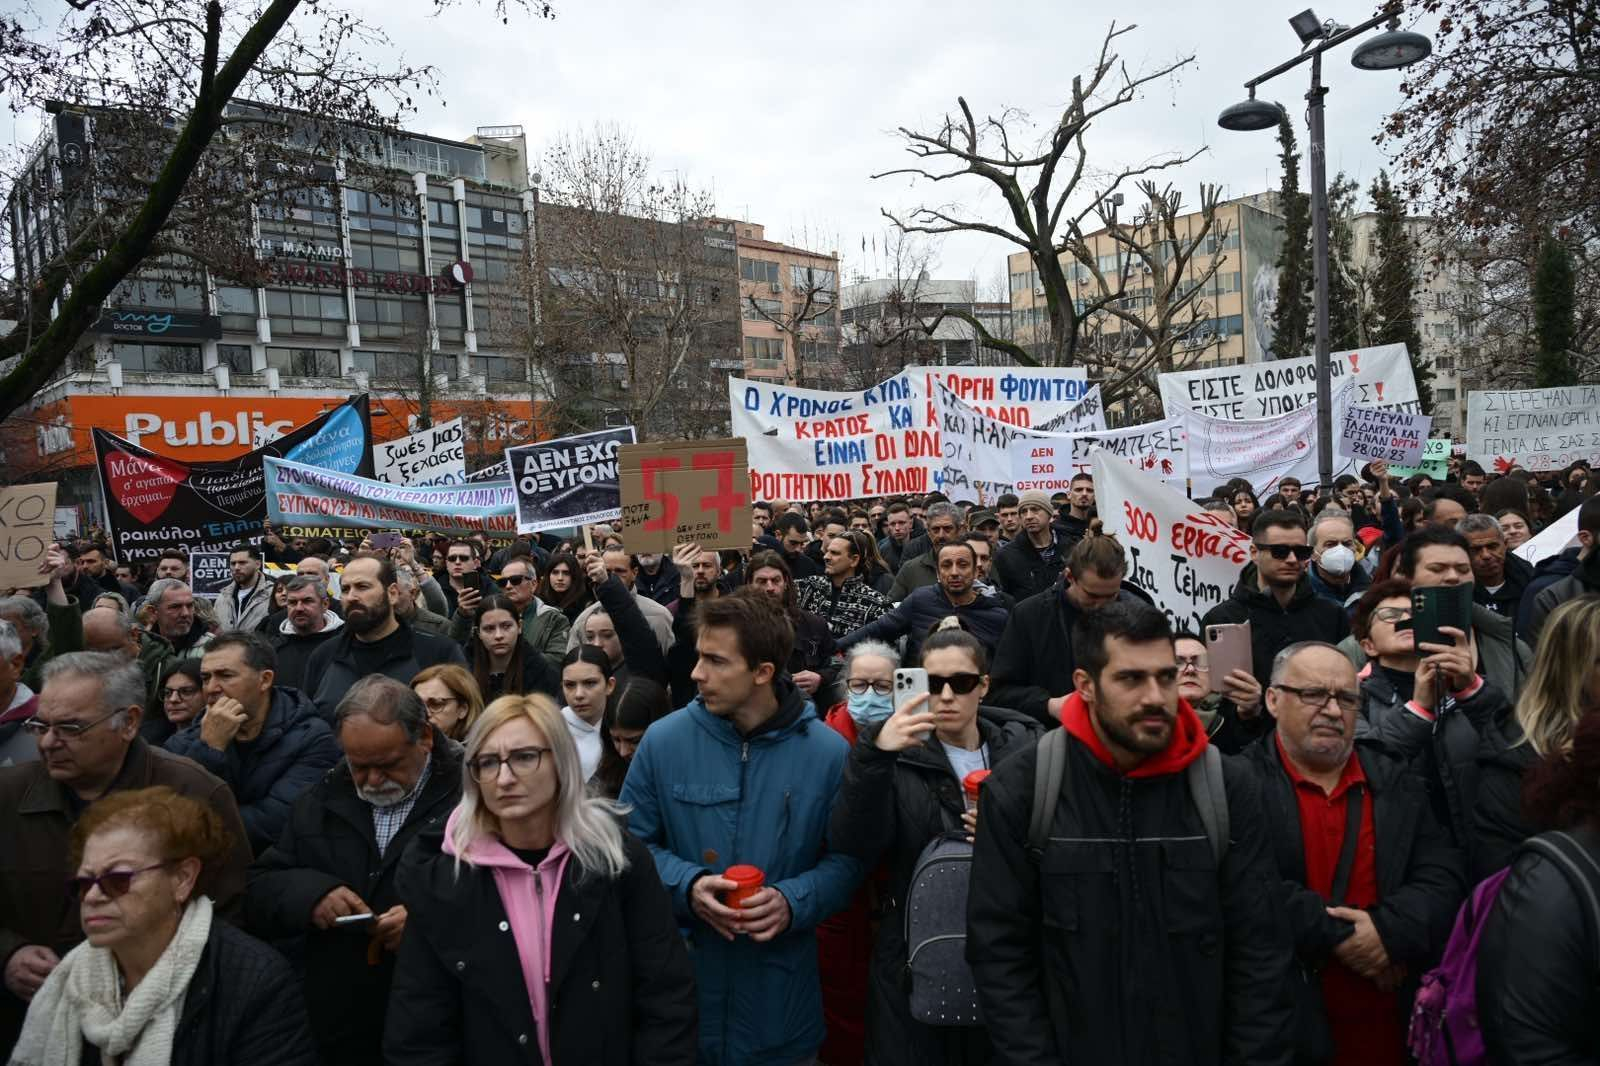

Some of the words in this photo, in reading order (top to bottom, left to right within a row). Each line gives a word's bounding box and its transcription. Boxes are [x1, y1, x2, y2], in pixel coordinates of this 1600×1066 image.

[1188, 375, 1244, 401] ΕΙΣΤΕ
[1254, 359, 1345, 392] ΔΟΛΟΦΟΟΙ
[770, 389, 853, 417] ΧΡΟΝΟΣ
[947, 374, 995, 401] ΟΡΓΗ
[124, 411, 294, 447] Public
[795, 413, 873, 440] ΚΡΑΤΟΣ
[1343, 429, 1389, 447] ΕΓΙΝΑΝ
[1391, 438, 1419, 449] ΟΡΓΗ
[523, 448, 571, 475] ΔΕΝ
[815, 438, 867, 467] ΕΙΝΑΙ
[875, 433, 897, 462] ΟΙ
[1030, 447, 1054, 458] ΔΕΝ
[519, 461, 621, 496] ΟΞΥΓΟΝ
[1031, 463, 1055, 474] ΕΧΩ
[365, 485, 393, 500] ΤΟΥ
[640, 450, 747, 535] 57
[1016, 479, 1070, 491] ΟΞΥΓΟΝΟ
[277, 494, 357, 516] ΣΥΓΚΡΟΥΣΗ
[487, 514, 516, 532] ΑΝΑ
[623, 503, 650, 515] ΠΟΤΕ
[1123, 500, 1159, 543] 300
[117, 526, 201, 545] ραικύλοι
[202, 517, 264, 537] Έλλη
[194, 568, 232, 579] ΟΞΥΓ
[198, 558, 227, 569] ΔΕΝ
